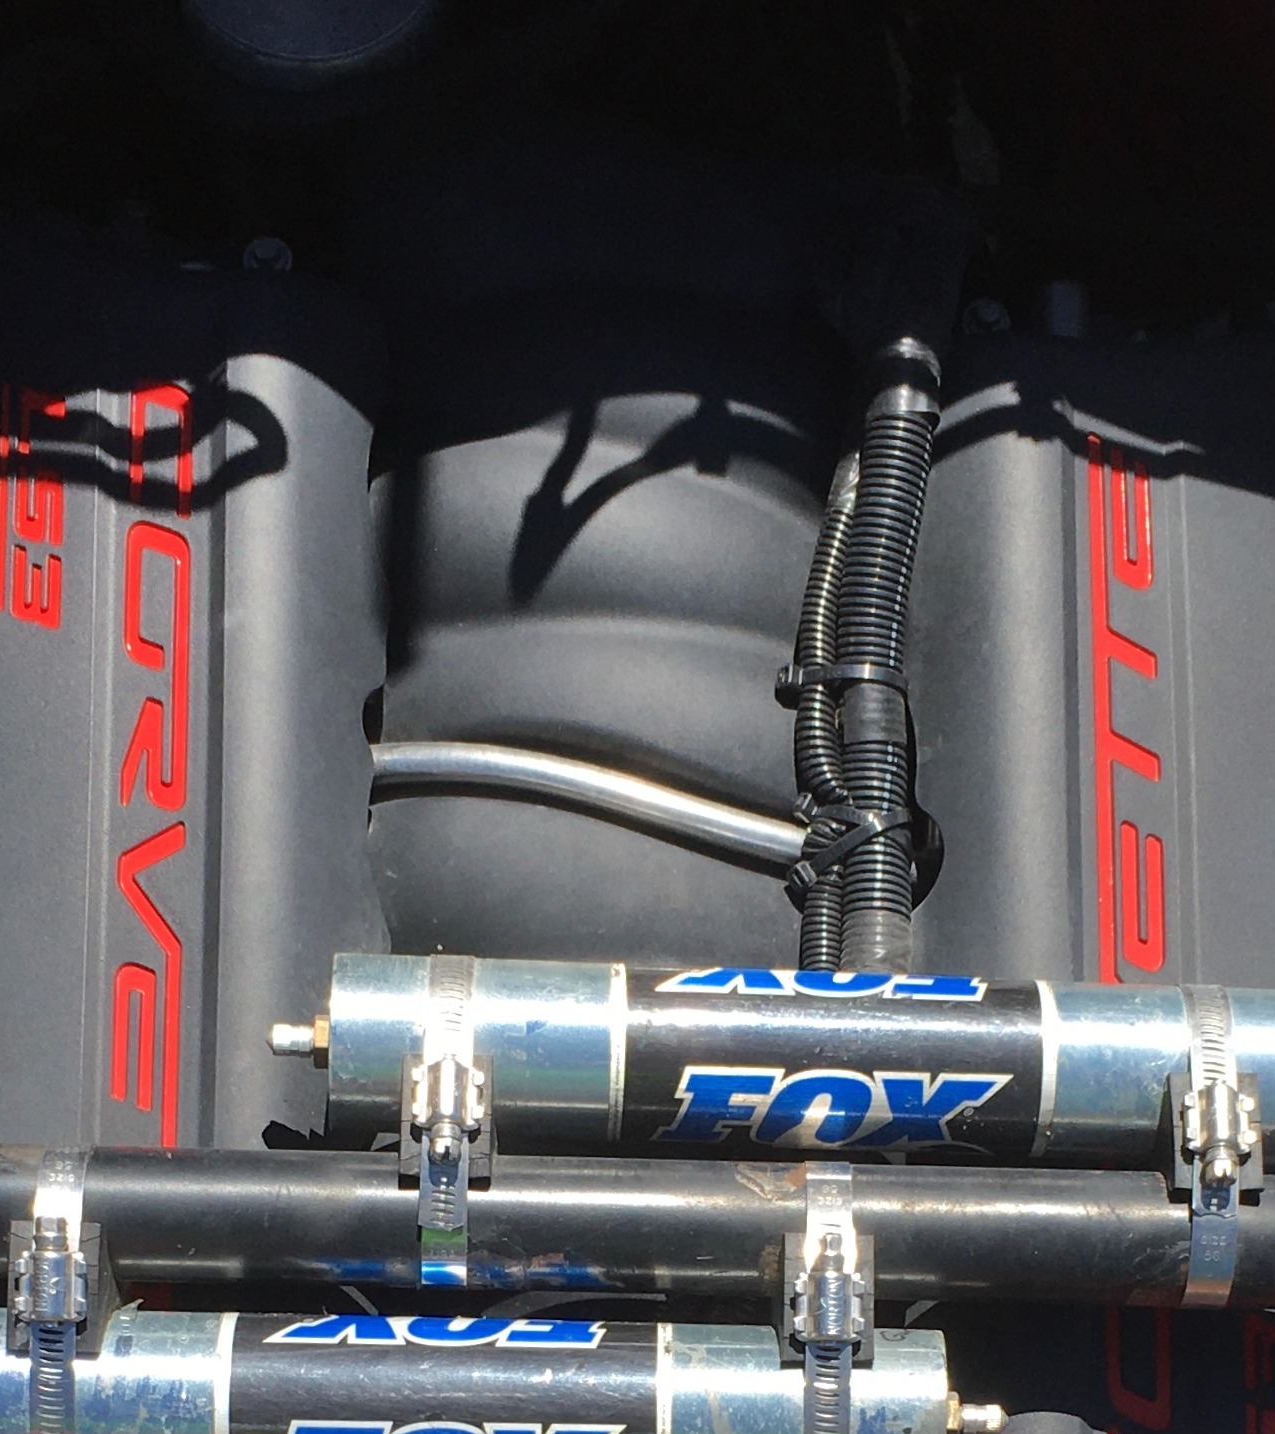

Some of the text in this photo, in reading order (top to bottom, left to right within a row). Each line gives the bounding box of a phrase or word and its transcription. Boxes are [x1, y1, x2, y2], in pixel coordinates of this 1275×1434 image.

[10, 385, 66, 630] LS3
[109, 379, 194, 1150] CORVE
[656, 1066, 1014, 1149] FOX
